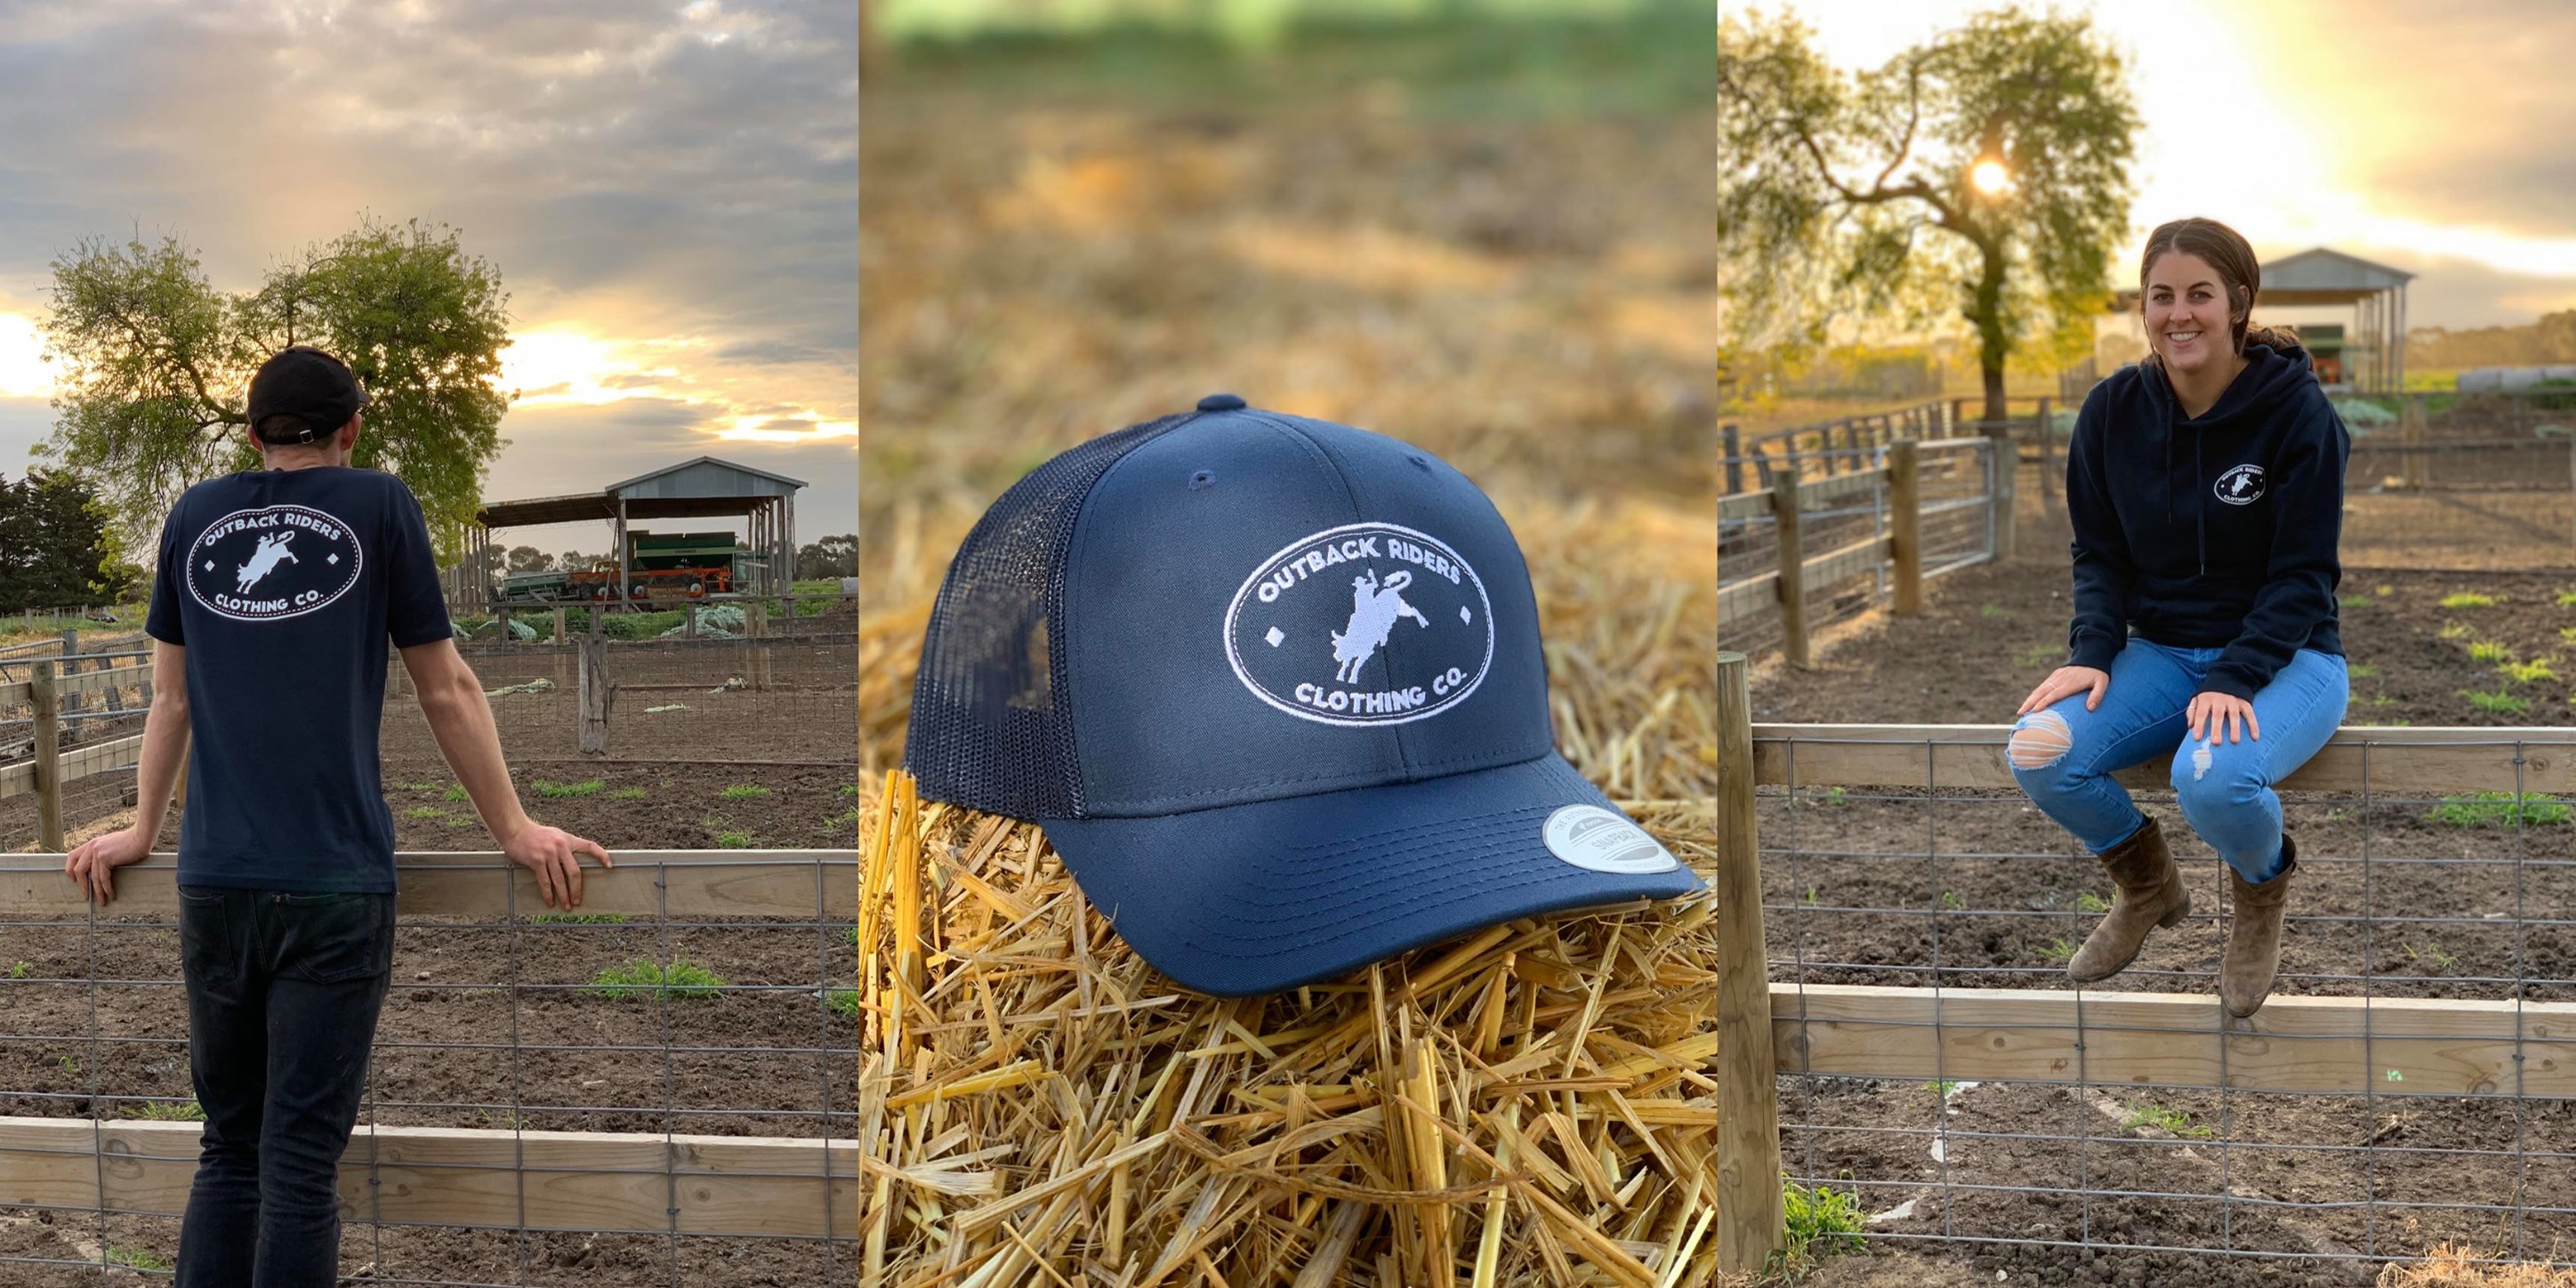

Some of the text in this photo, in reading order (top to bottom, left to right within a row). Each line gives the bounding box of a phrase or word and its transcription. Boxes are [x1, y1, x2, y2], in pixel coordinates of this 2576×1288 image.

[205, 512, 341, 546] OUTBACK RIDERS
[1259, 537, 1461, 602] OUTBACK RIDERS
[215, 590, 324, 613] CLOTHING CO.
[1295, 667, 1468, 713] CLOTHING CO.
